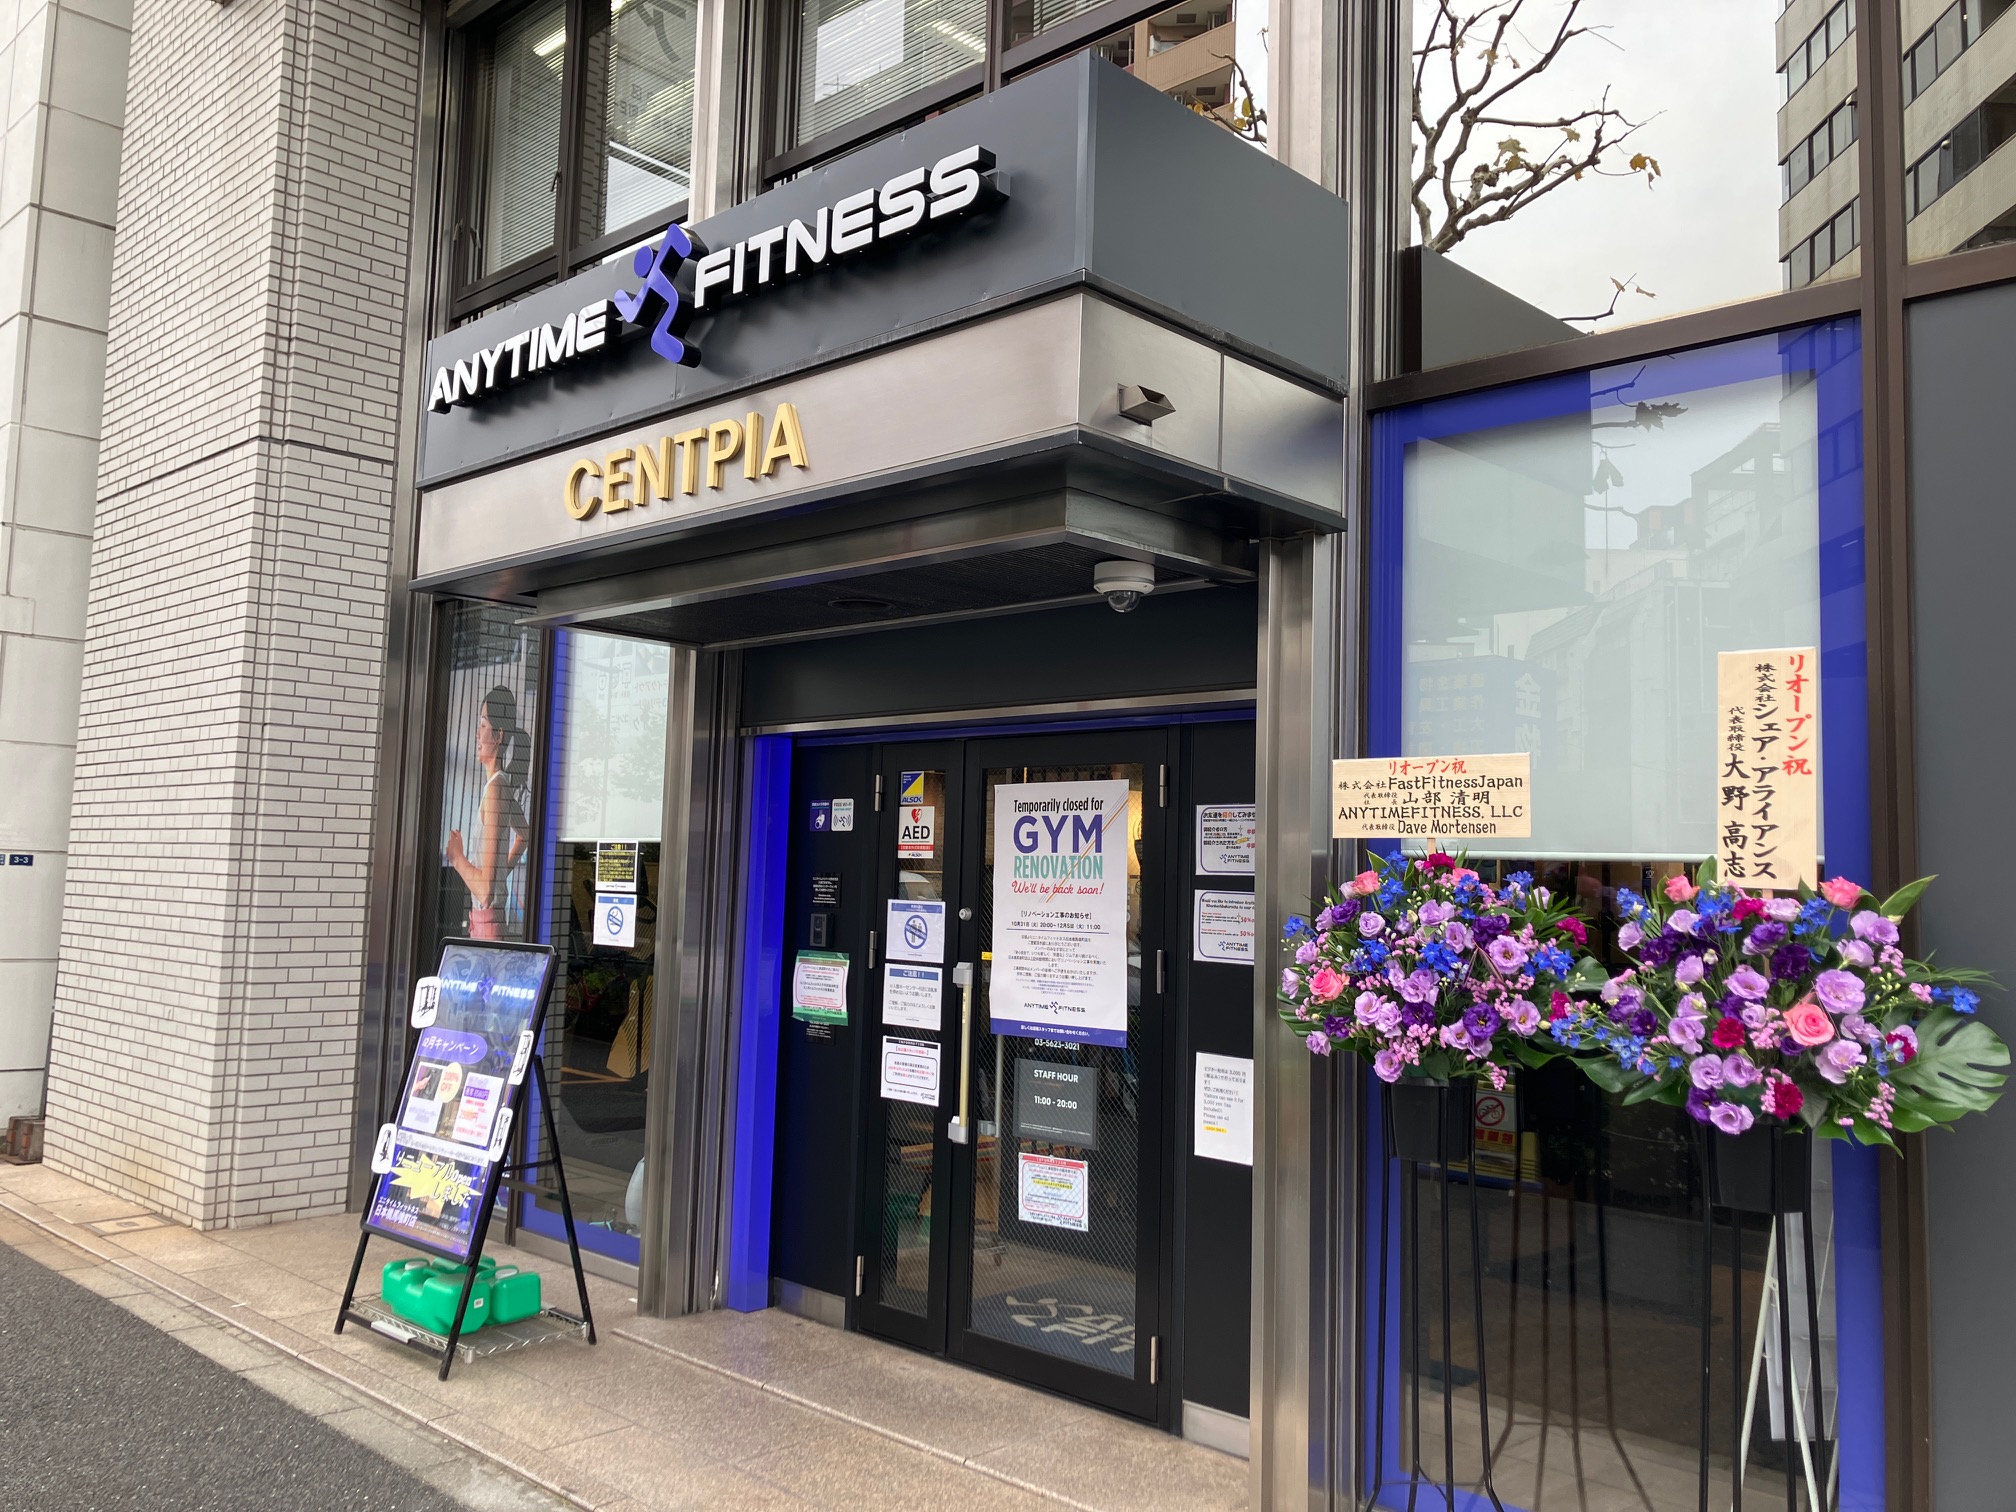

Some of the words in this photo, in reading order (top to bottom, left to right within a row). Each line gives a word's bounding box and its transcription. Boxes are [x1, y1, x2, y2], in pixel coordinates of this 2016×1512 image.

[427, 298, 609, 413] ANYTIME
[694, 144, 984, 308] FITNESS
[563, 402, 810, 521] CENTPIA
[1782, 654, 1812, 777] リオープン祝
[1727, 706, 1746, 752] 代表取締役
[1389, 757, 1467, 775] リオープン祝
[1721, 753, 1751, 811] 大野
[1014, 798, 1060, 814] Temporarily
[1063, 797, 1089, 811] closed
[1091, 797, 1104, 810] for
[1402, 791, 1442, 806] 山部
[1450, 790, 1490, 805] 清明
[1491, 806, 1523, 818] LLC
[902, 826, 930, 840] AED
[1013, 814, 1103, 853] GYM
[1398, 820, 1427, 834] Dave
[1430, 820, 1497, 834] Mortensen
[1722, 821, 1748, 878] 高志
[1014, 855, 1103, 879] RENOVATION
[1011, 880, 1037, 894] We'll
[1040, 883, 1050, 894] be
[1052, 883, 1073, 894] back
[1077, 882, 1105, 895] soon!
[491, 984, 536, 1000] FITNESS
[1024, 1002, 1049, 1010] ANYTIME
[1058, 1005, 1086, 1013] FITNESS
[422, 1036, 479, 1056] 12月キャンペーン
[1034, 1038, 1080, 1051] 03-5623-3021
[1033, 1069, 1056, 1080] STAFF
[1057, 1071, 1079, 1083] HOUR
[1034, 1095, 1051, 1106] 11:00
[1056, 1097, 1077, 1109] 20:00
[432, 1181, 472, 1209] しました
